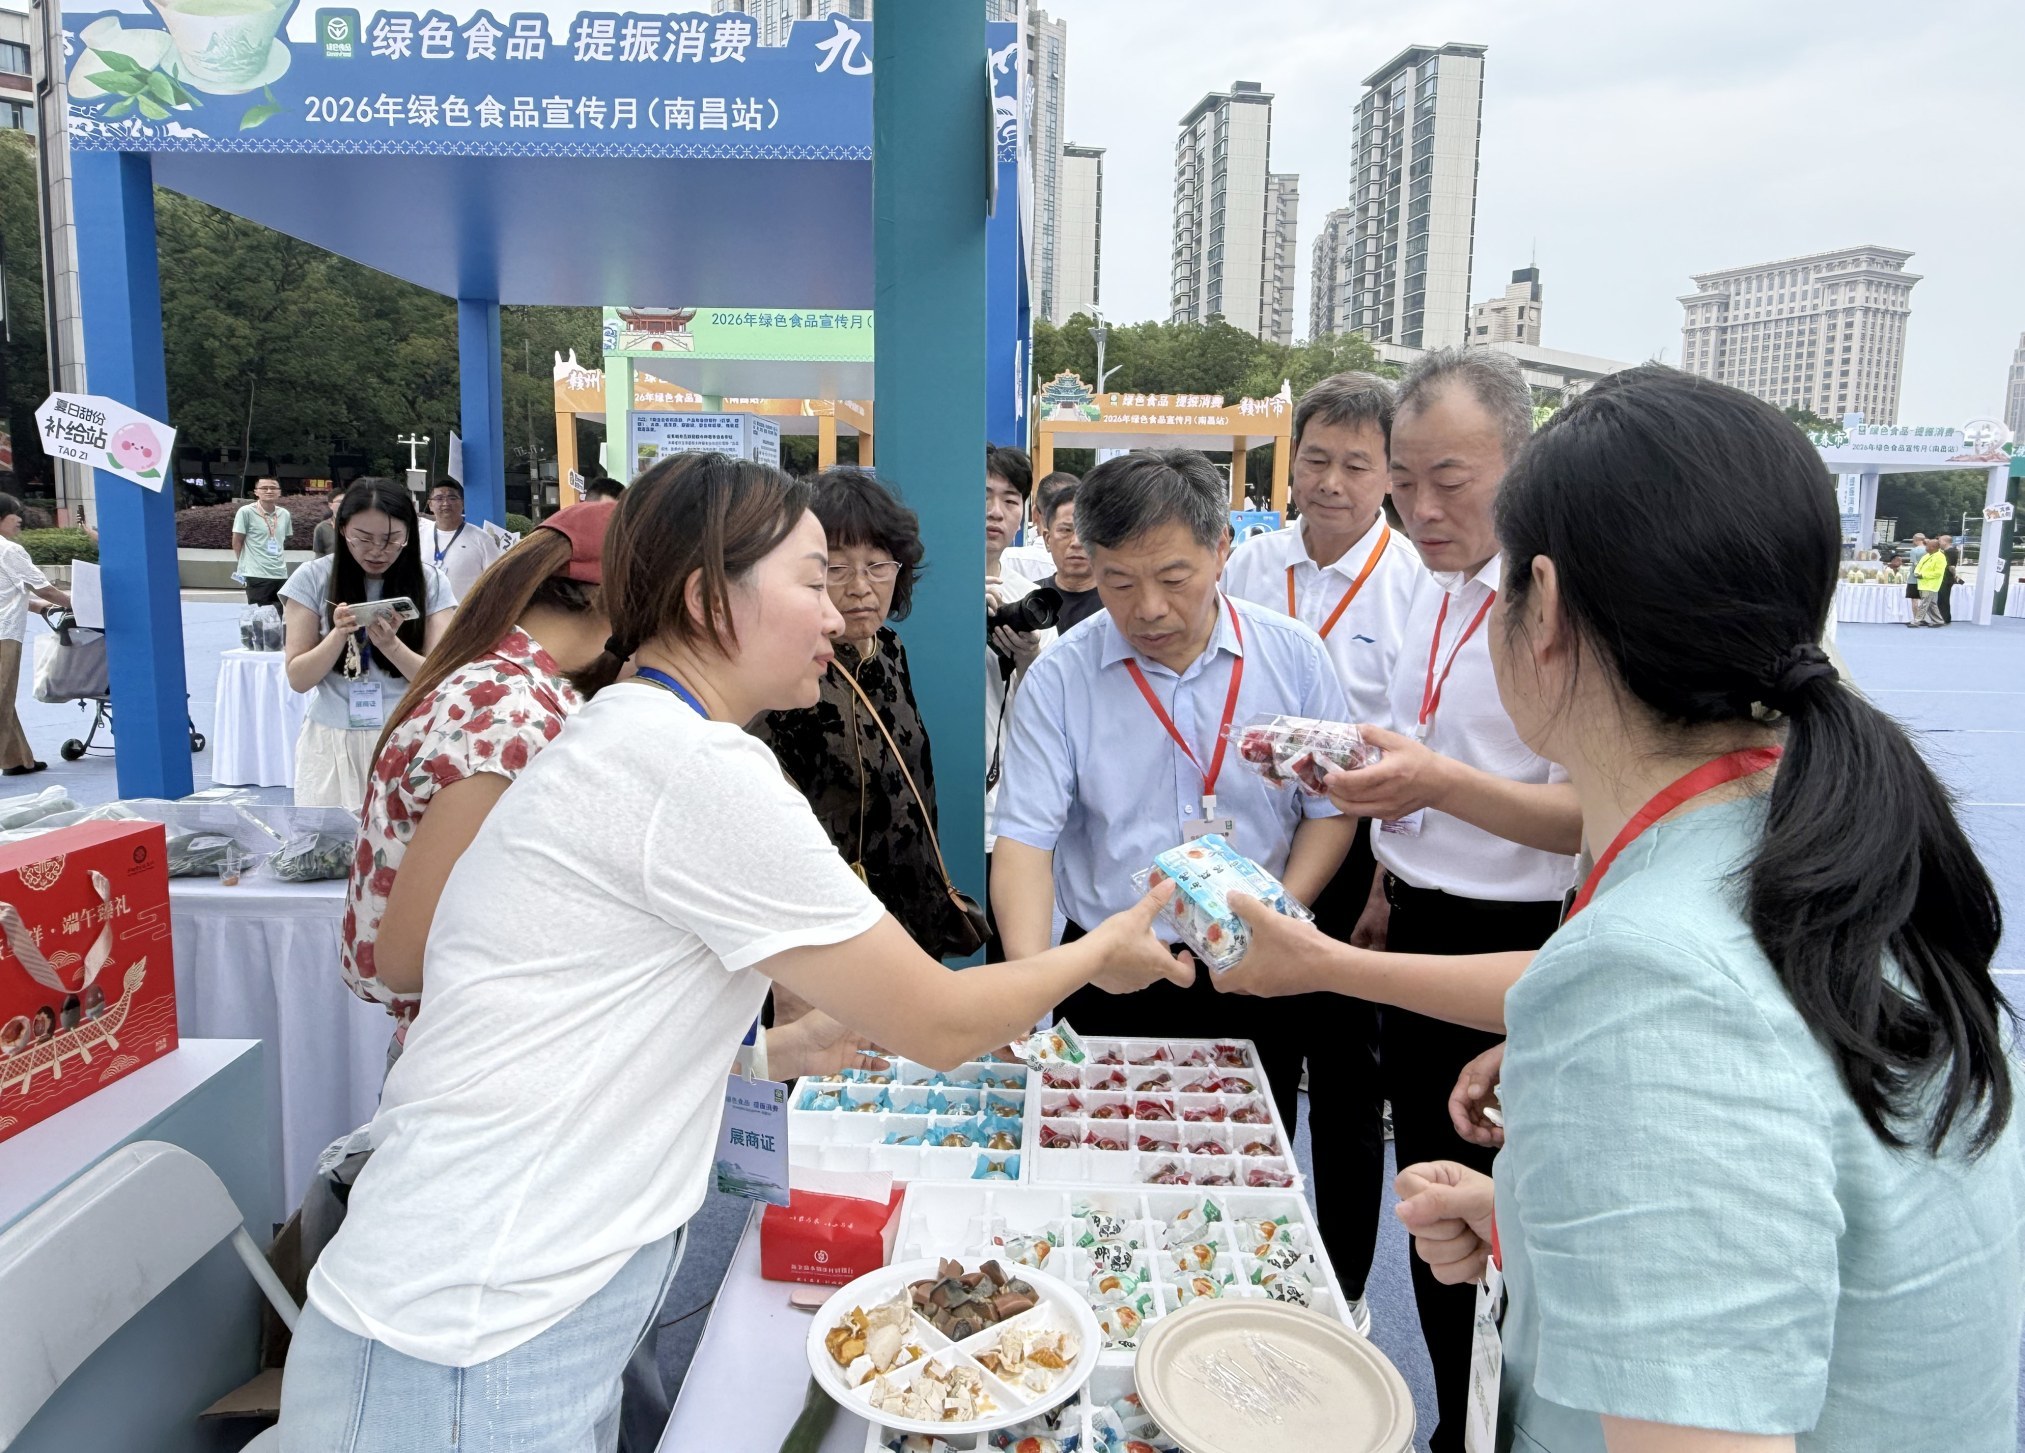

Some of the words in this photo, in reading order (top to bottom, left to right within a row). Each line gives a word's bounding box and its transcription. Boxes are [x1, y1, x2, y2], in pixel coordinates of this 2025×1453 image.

[371, 17, 546, 61] 绿色食品
[573, 18, 751, 63] 提振消费
[814, 19, 873, 76] 九
[305, 93, 779, 131] 2026年绿色食品宣传月（南昌站）
[567, 369, 605, 393] 赣州
[54, 398, 106, 426] 夏日甜份
[1122, 394, 1169, 408] 绿色食品
[1238, 397, 1286, 419] 赣州市
[45, 416, 108, 450] 补给站
[58, 445, 76, 458] TAO
[78, 450, 88, 461] ZI
[730, 1127, 775, 1152] 展商证
